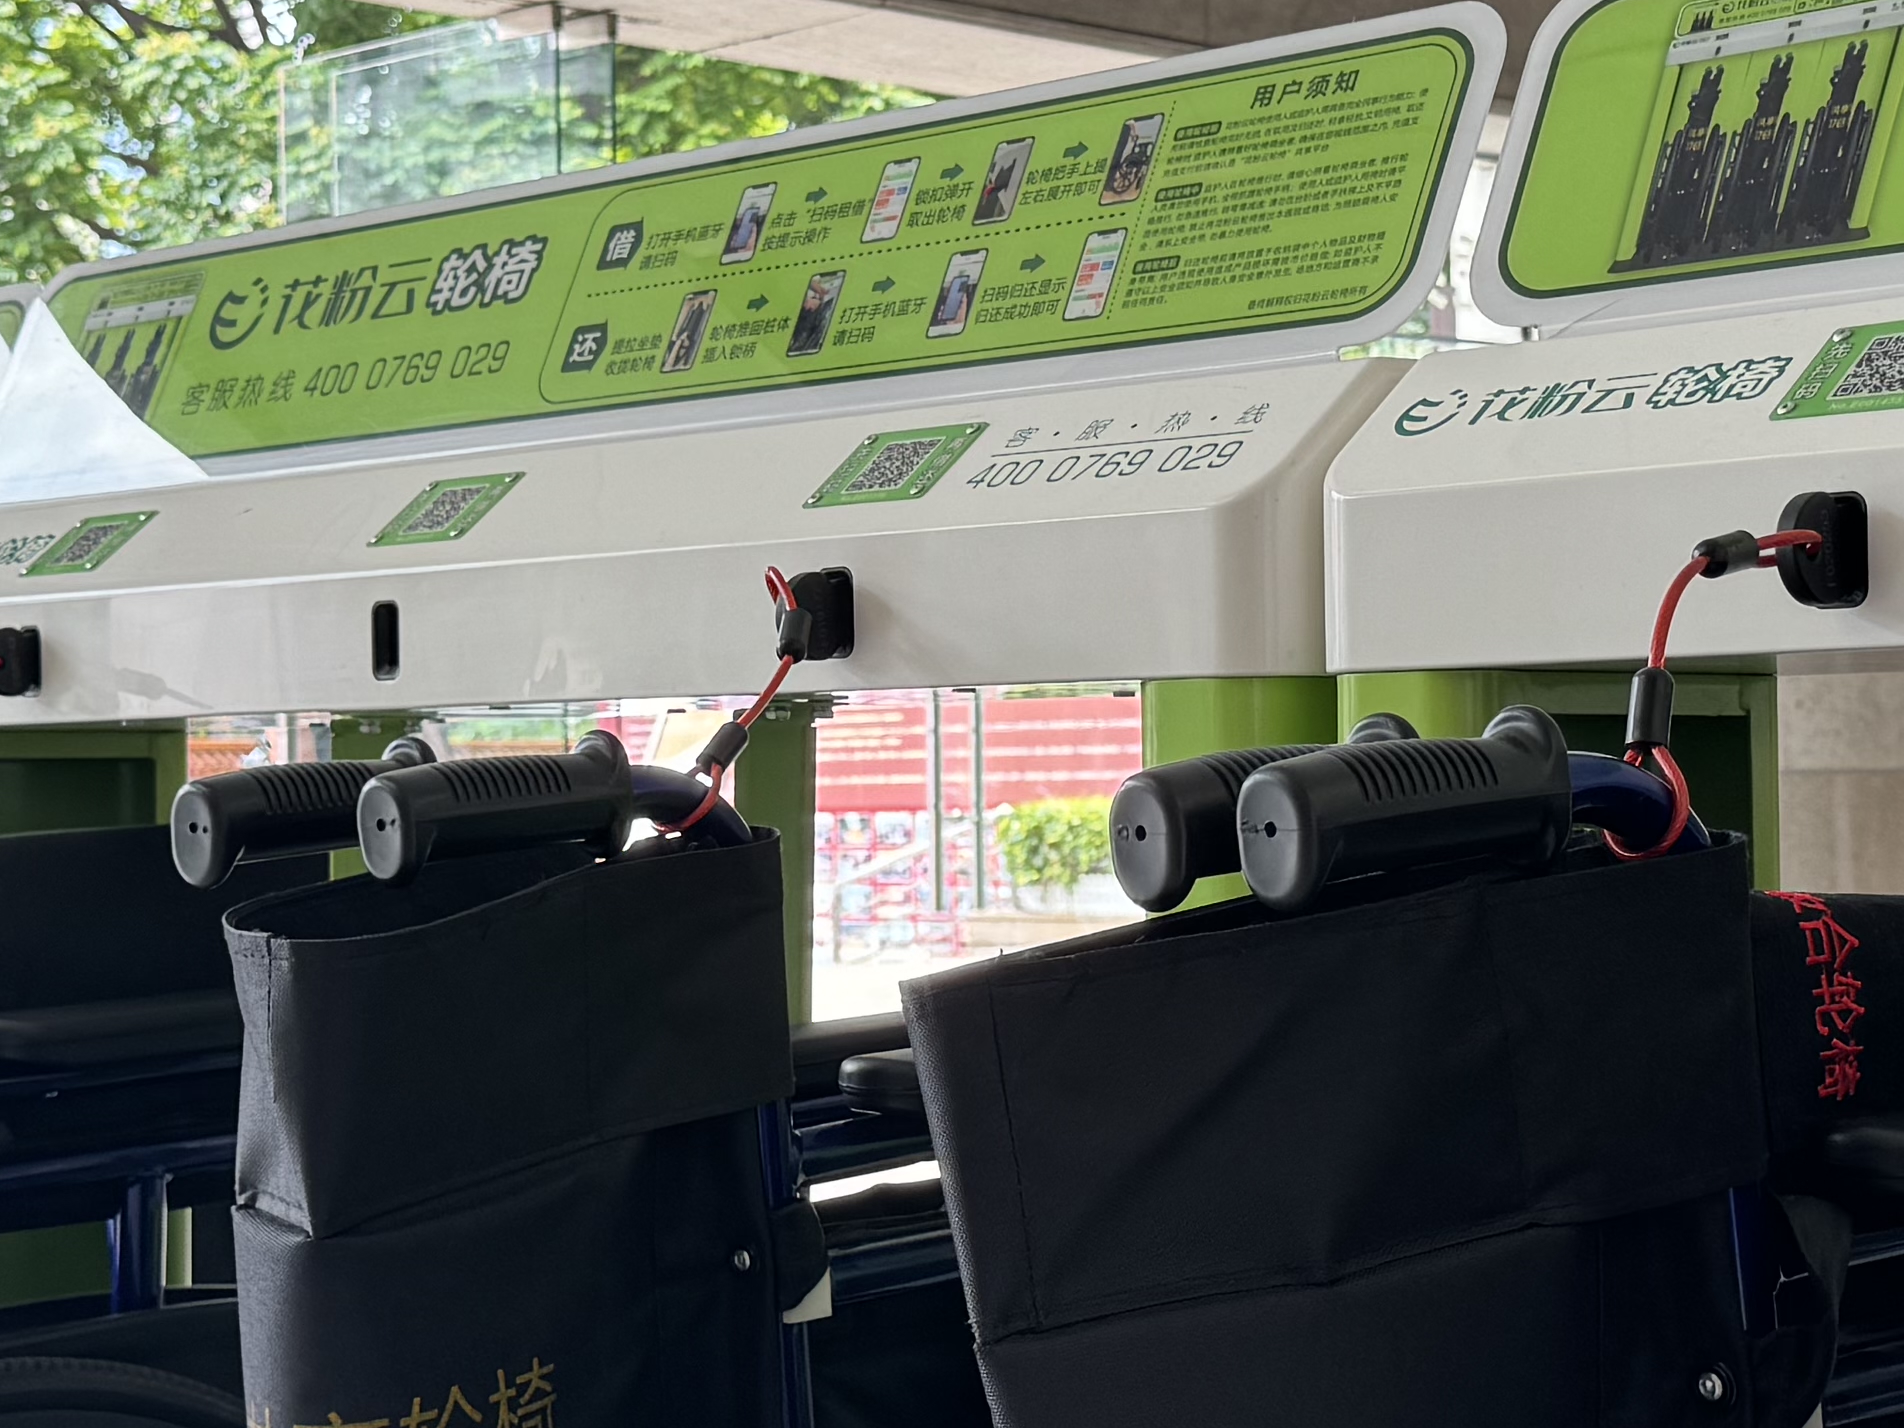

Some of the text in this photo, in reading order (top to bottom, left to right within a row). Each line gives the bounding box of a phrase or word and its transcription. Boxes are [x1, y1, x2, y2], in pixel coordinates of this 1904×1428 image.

[1250, 68, 1361, 110] 用户须知
[906, 203, 967, 228] 取出轮椅
[606, 228, 638, 262] 借
[760, 226, 832, 252] 按提示操作
[272, 235, 549, 336] 花粉云轮椅
[839, 296, 929, 326] 打开手机蓝牙
[568, 332, 602, 363] 还
[832, 325, 876, 347] 请扫码
[180, 340, 511, 416] 客服热线 400 0769 029
[1467, 355, 1794, 427] 花粉云轮椅
[966, 459, 1045, 489] 400
[1045, 448, 1154, 483] 0769
[1156, 440, 1244, 473] 029
